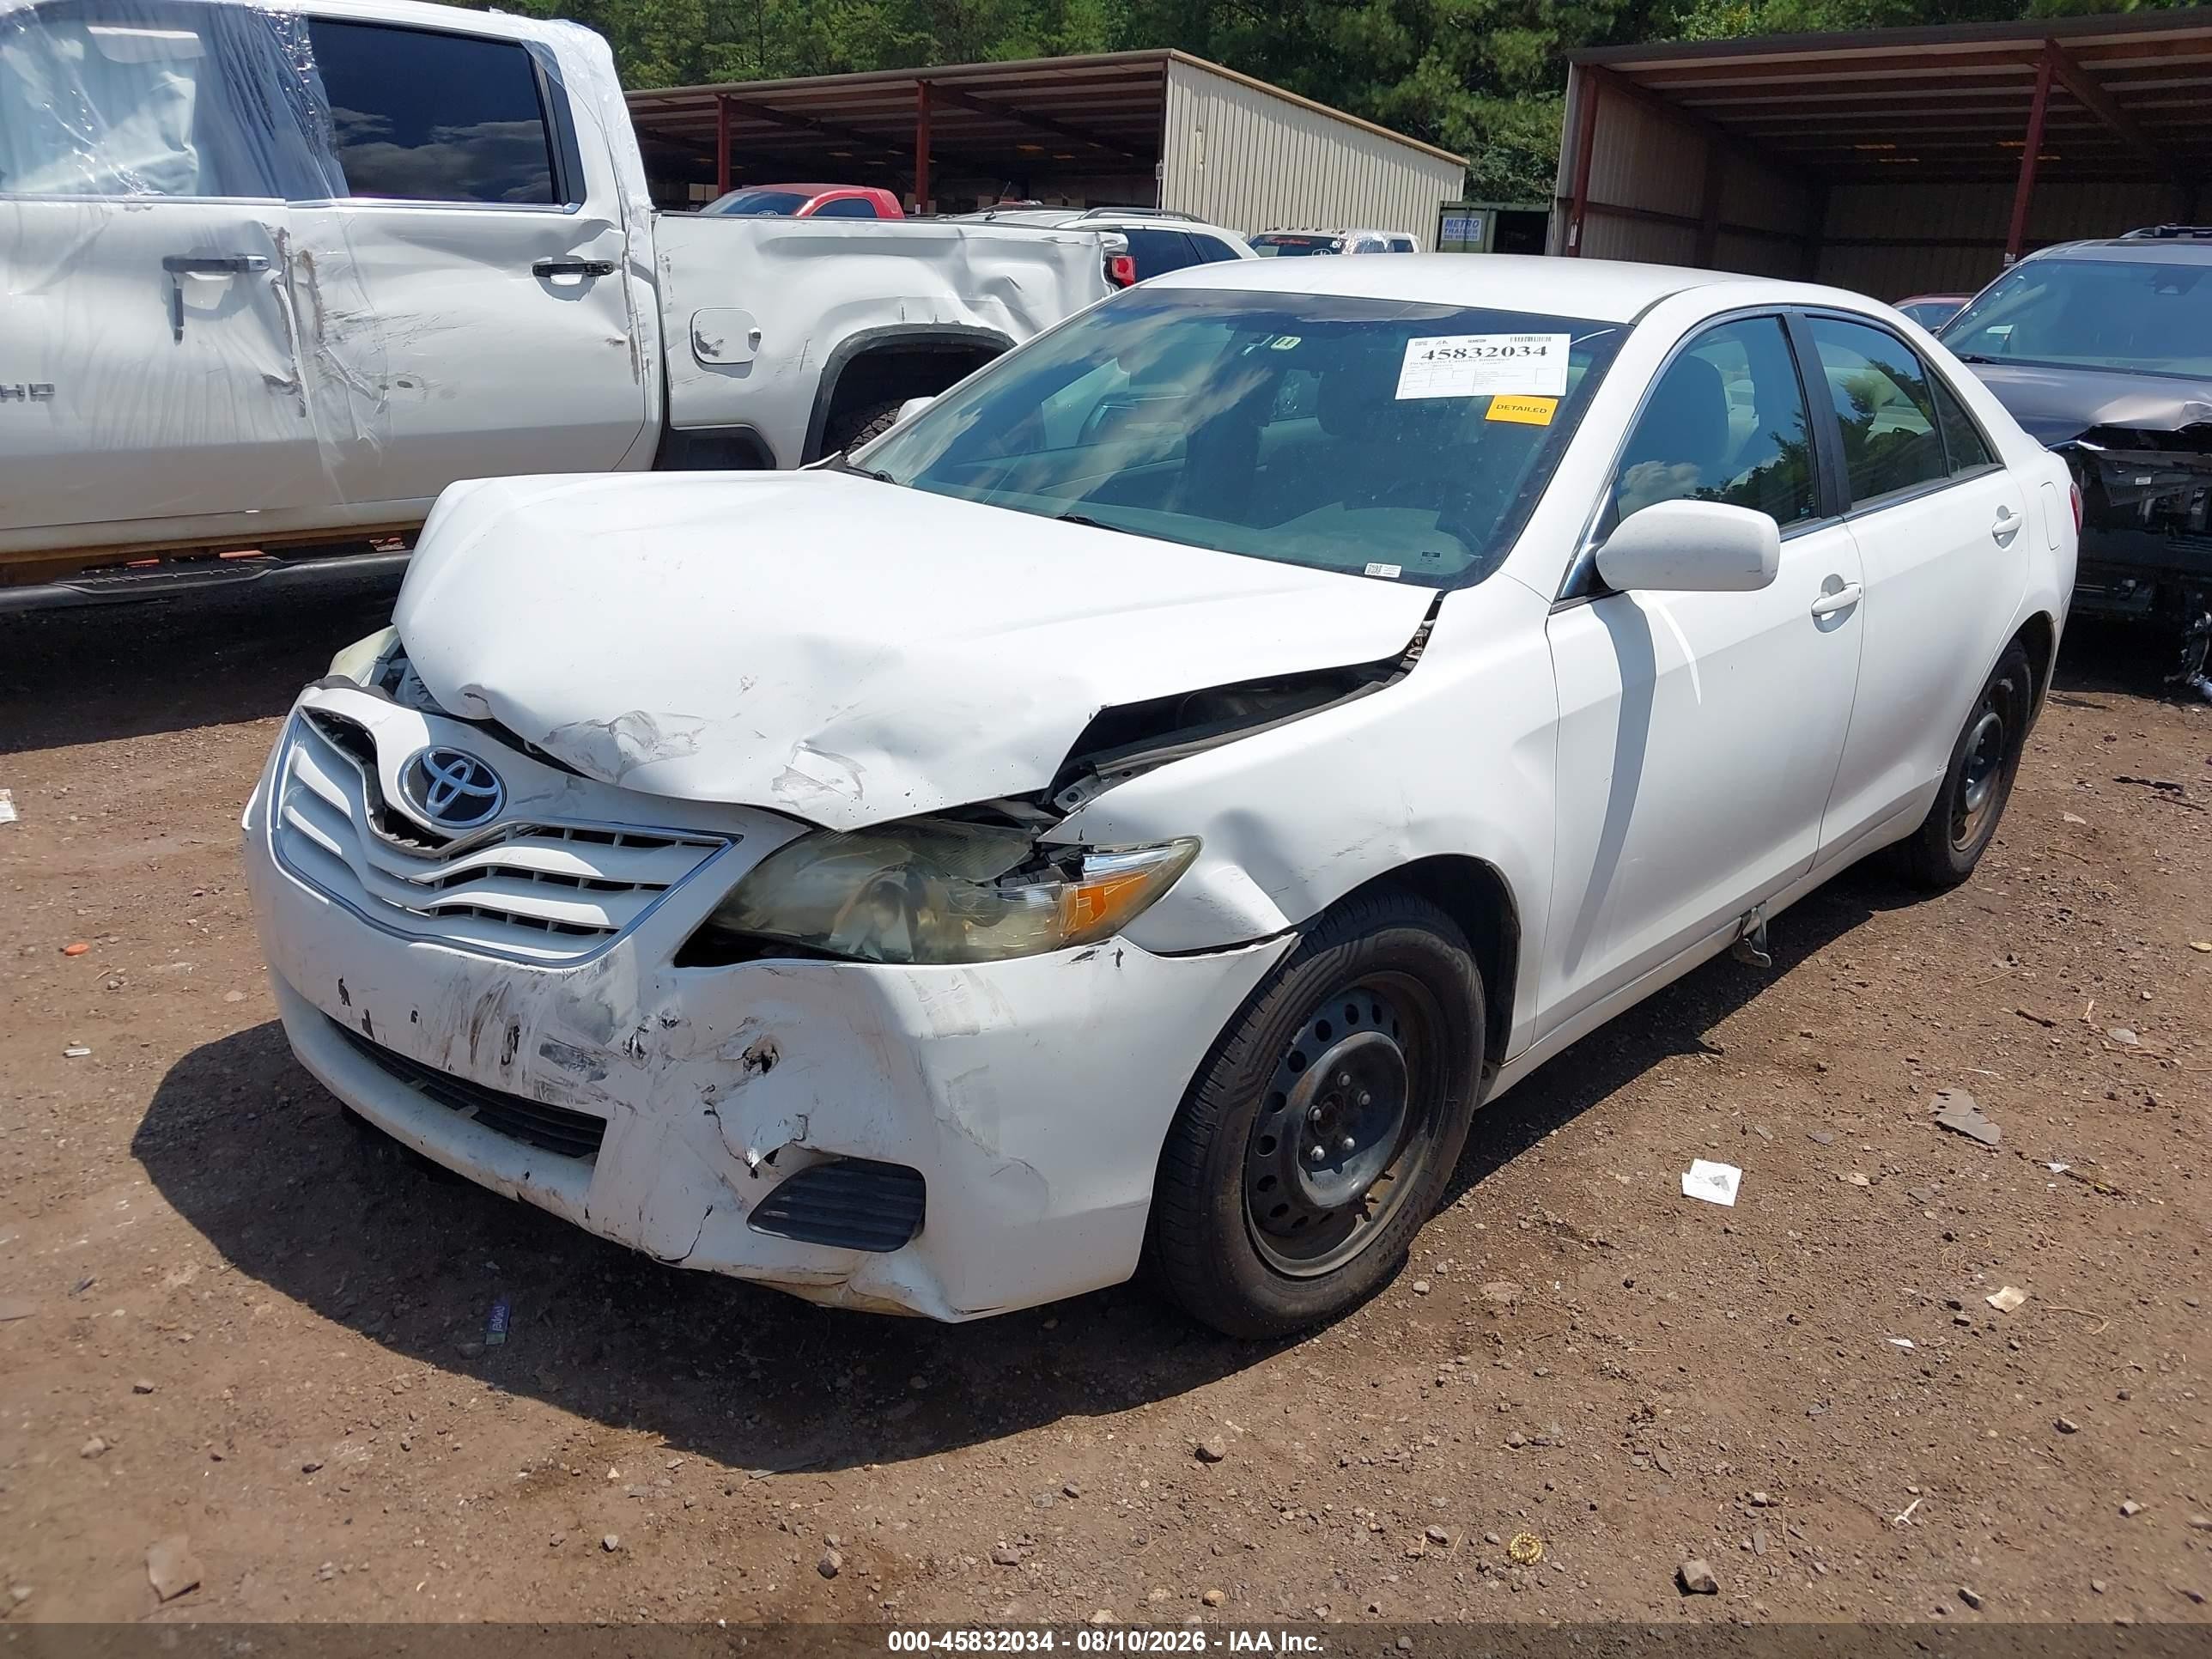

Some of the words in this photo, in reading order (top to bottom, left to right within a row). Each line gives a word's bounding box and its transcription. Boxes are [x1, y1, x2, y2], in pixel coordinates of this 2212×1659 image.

[1444, 219, 1480, 228] METRO
[1420, 345, 1548, 361] 45832034
[1496, 403, 1548, 414] DETAILED
